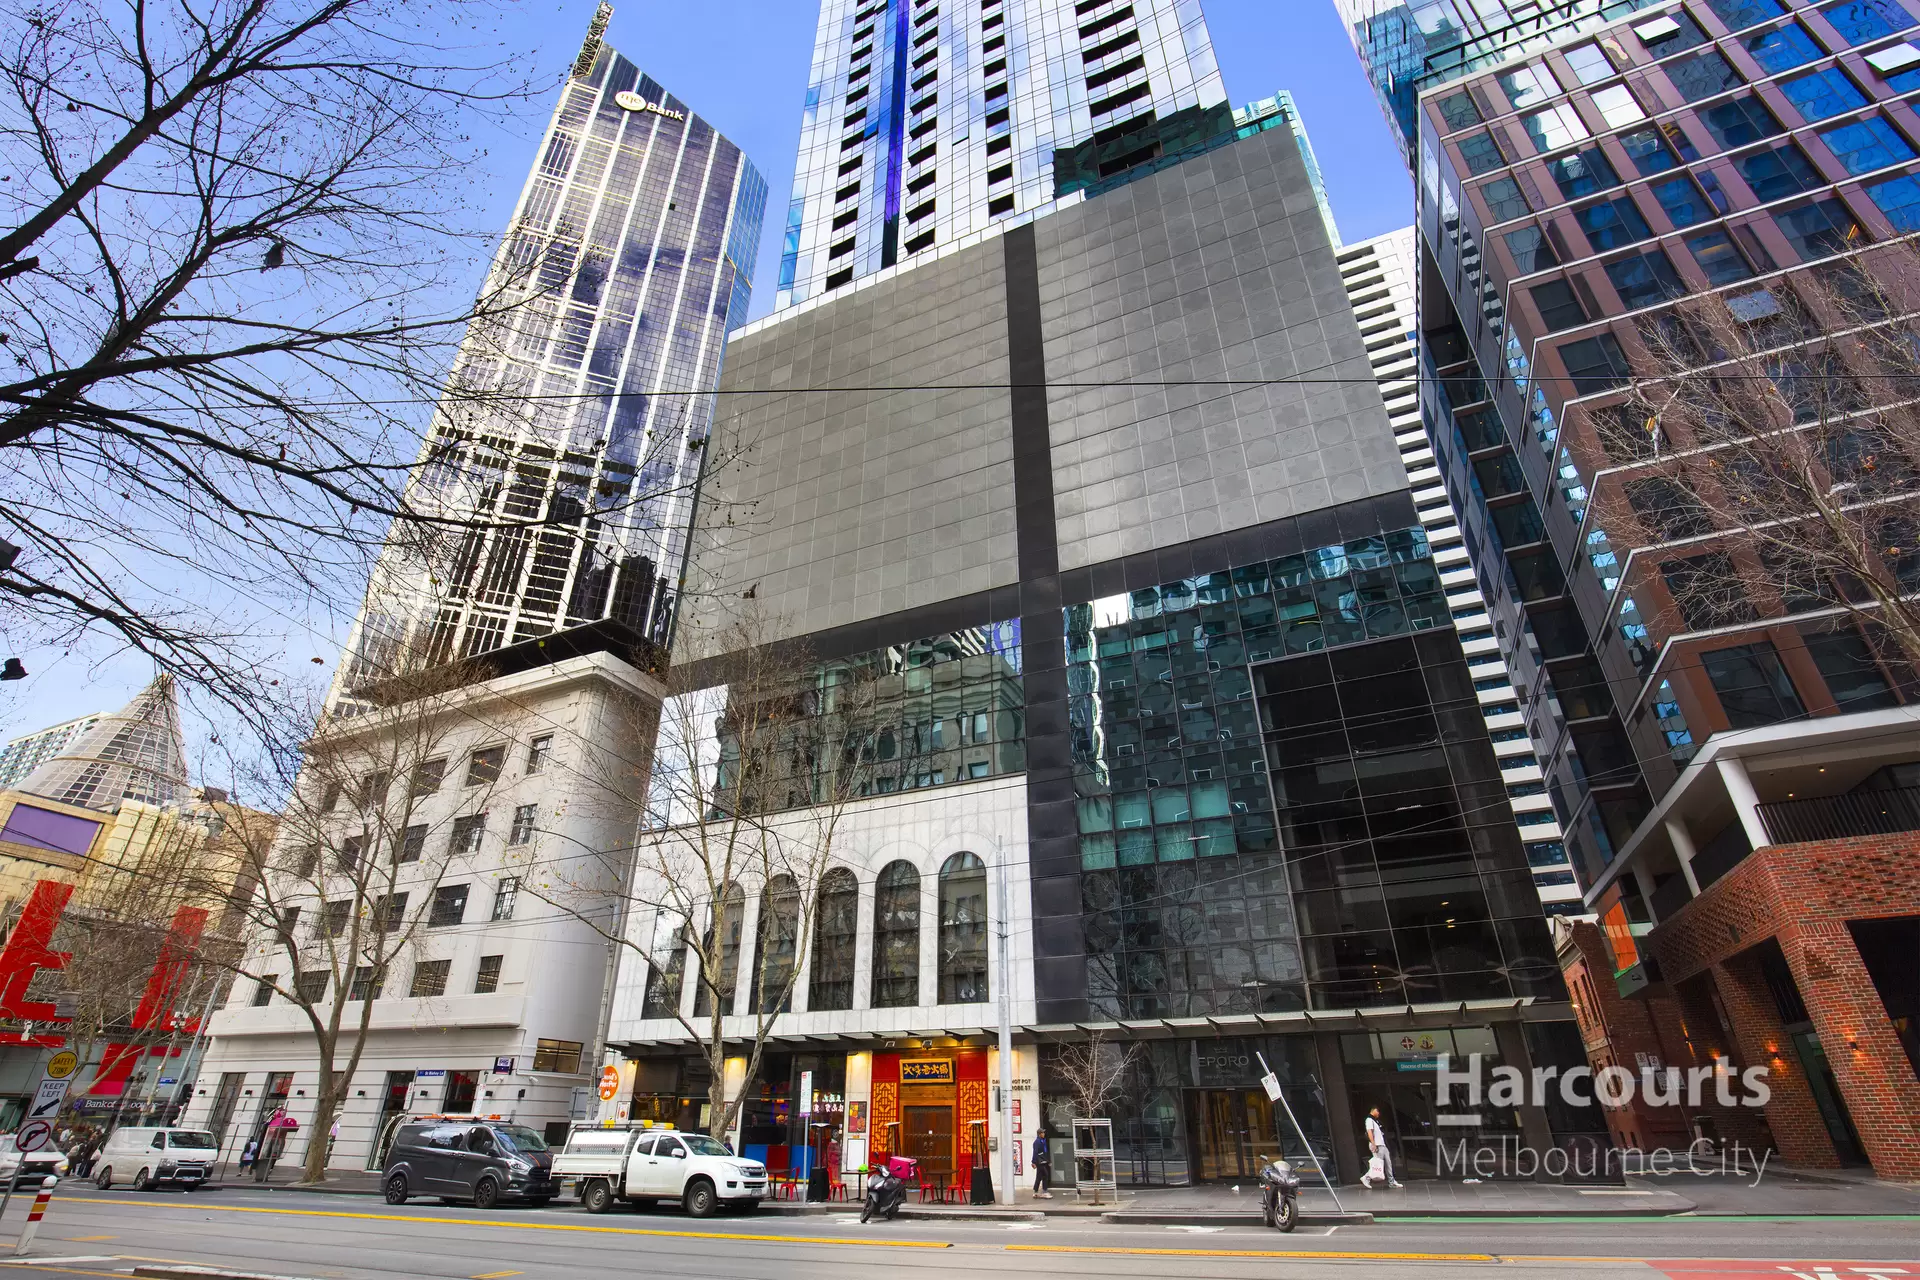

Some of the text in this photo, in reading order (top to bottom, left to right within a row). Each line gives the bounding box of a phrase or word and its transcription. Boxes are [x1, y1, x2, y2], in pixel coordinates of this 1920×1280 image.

[646, 102, 684, 121] Bank
[51, 1057, 75, 1066] SAFETY
[1198, 1055, 1250, 1067] EPORO
[52, 1066, 68, 1075] ZONE
[43, 1082, 65, 1090] KEEP
[41, 1090, 60, 1098] LEFT
[84, 1099, 107, 1108] Bank
